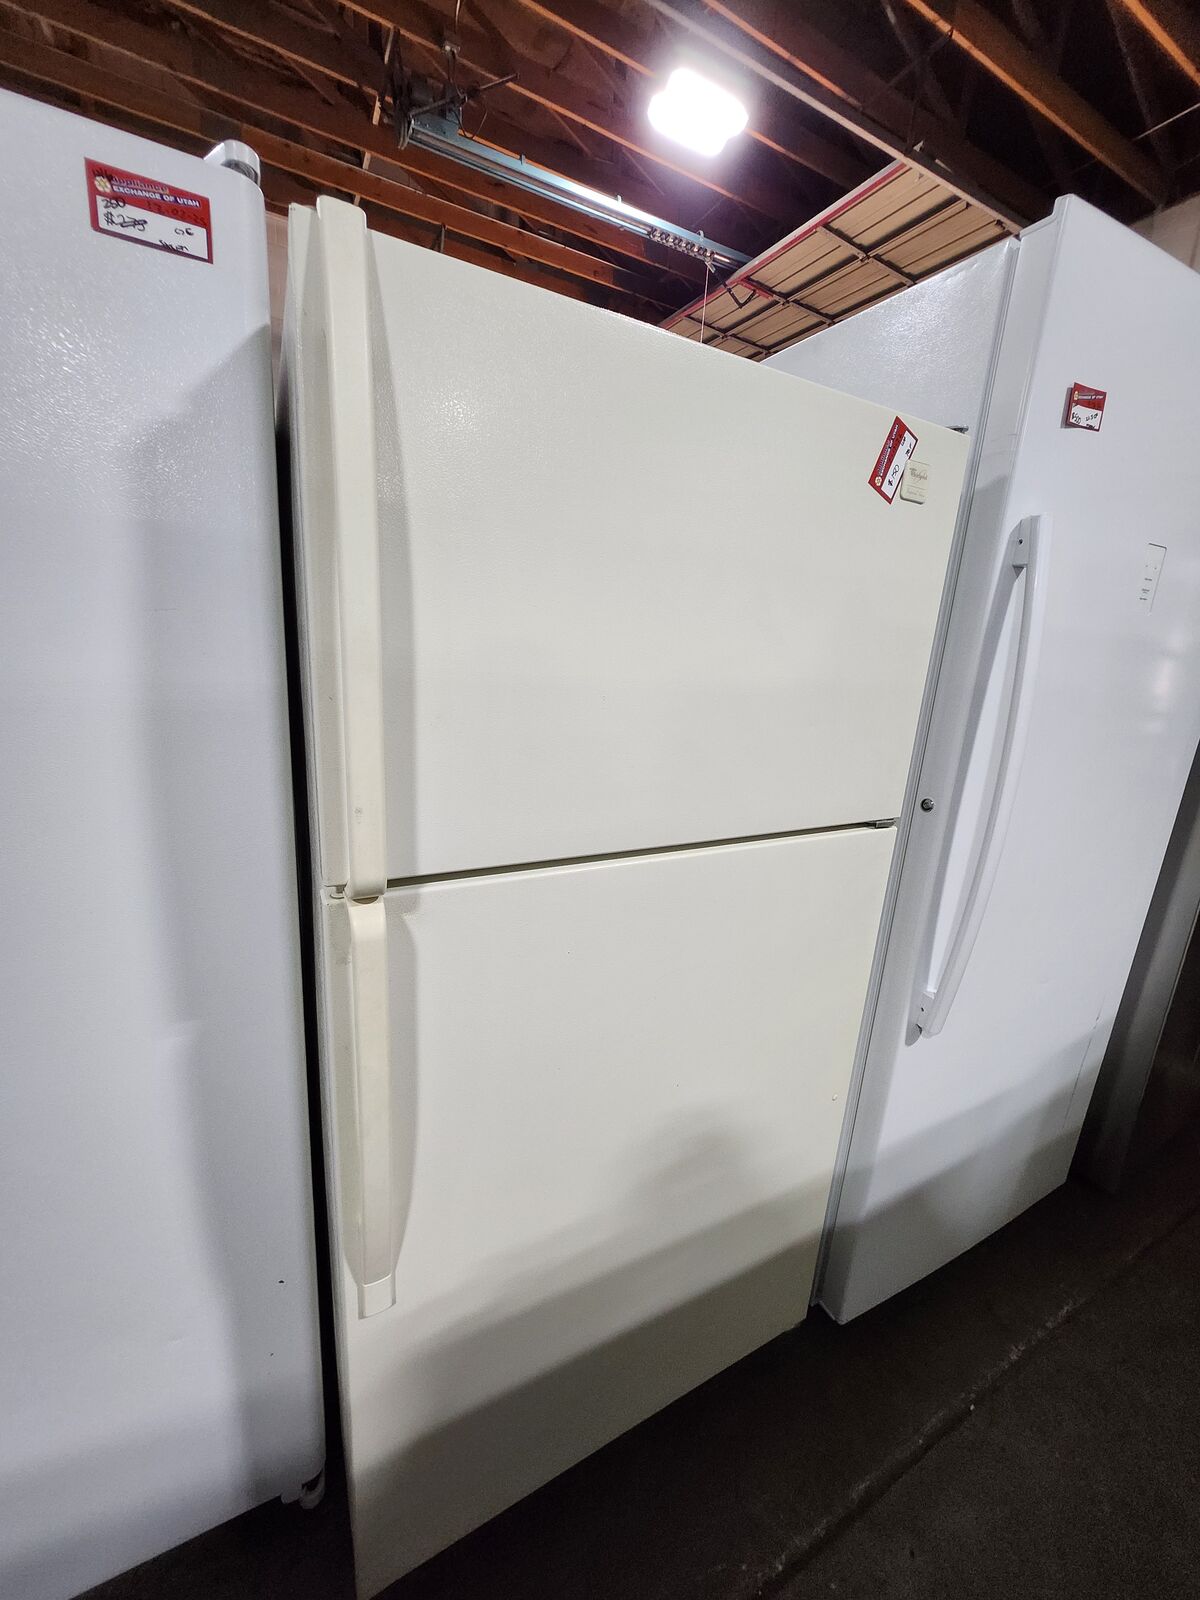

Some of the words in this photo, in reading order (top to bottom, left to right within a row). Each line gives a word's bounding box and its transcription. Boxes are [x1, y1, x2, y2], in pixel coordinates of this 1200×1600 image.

[112, 185, 162, 201] EXCHANGE
[162, 194, 177, 204] OF
[176, 196, 201, 208] UTAH
